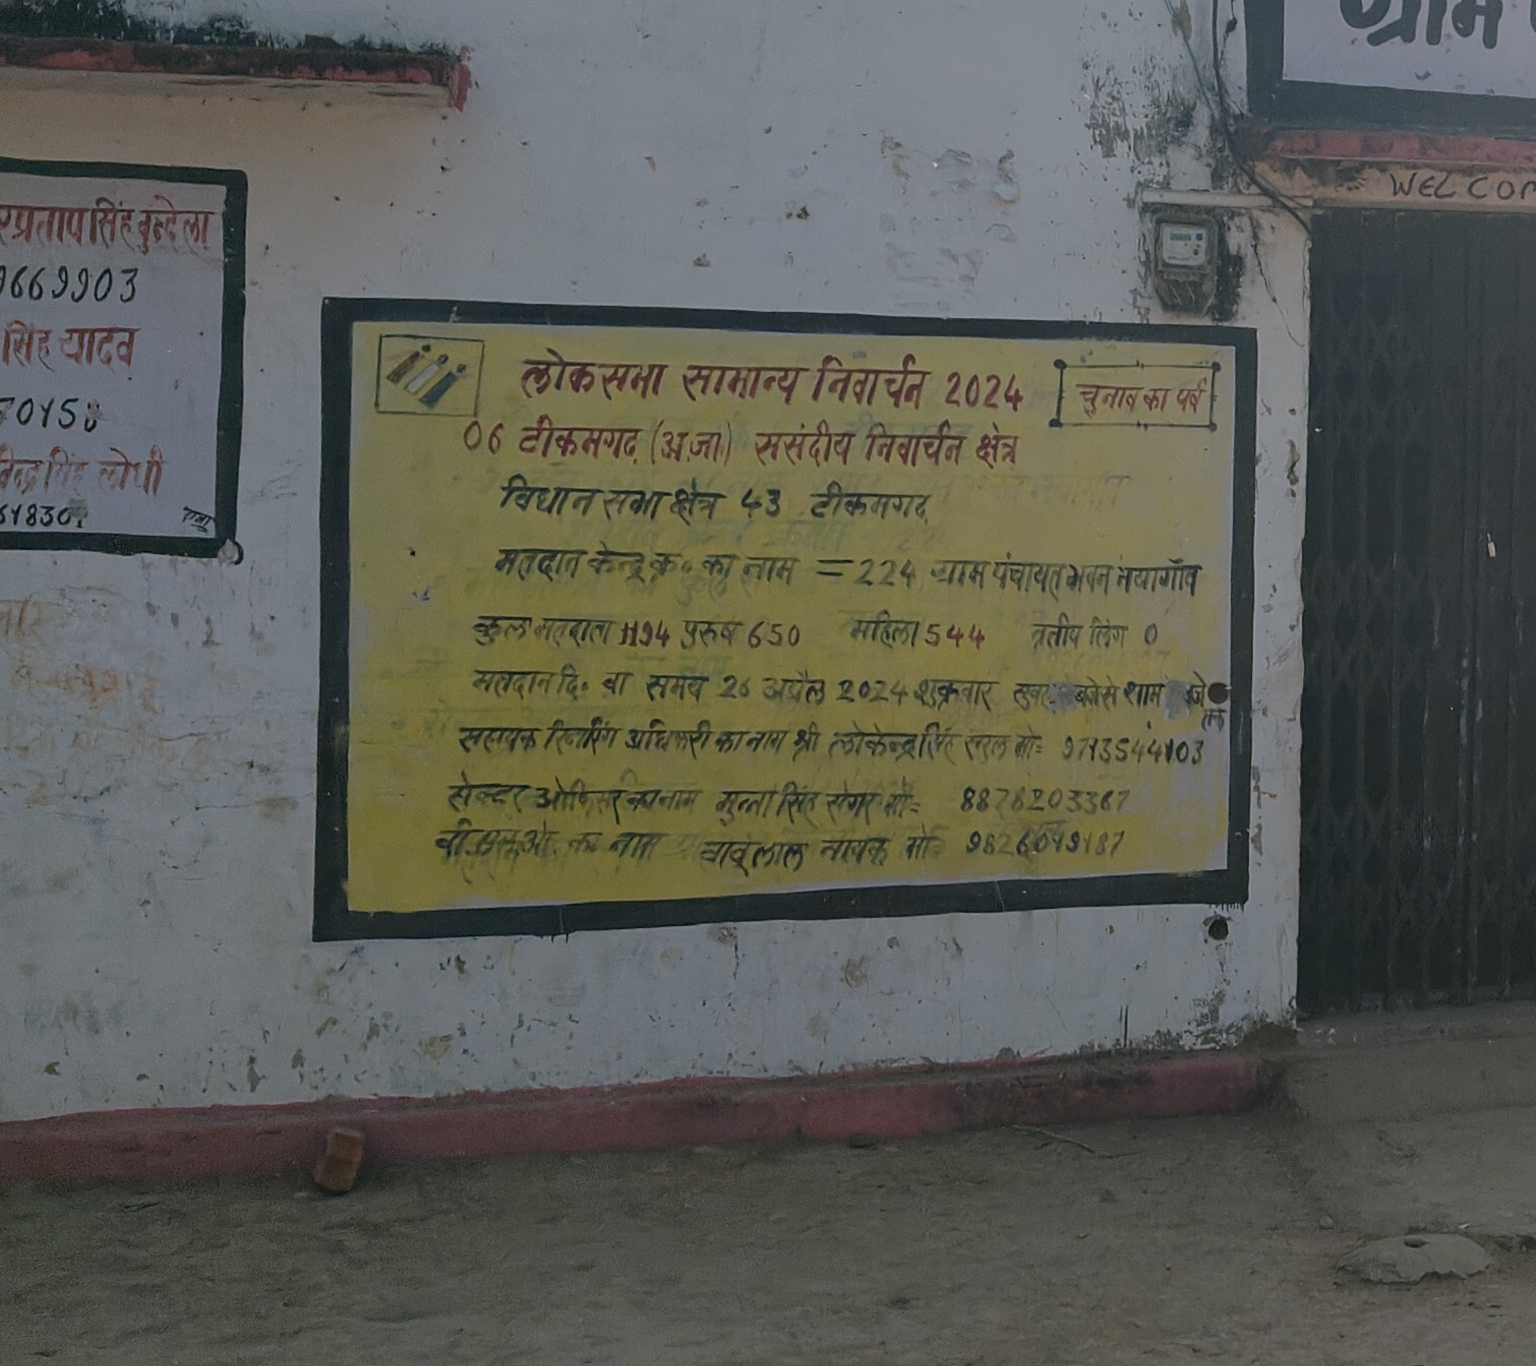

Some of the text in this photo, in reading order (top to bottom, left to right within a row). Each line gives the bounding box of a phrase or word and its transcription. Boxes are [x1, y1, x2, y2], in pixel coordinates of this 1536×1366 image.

[89, 197, 136, 251] सिंह
[60, 327, 141, 370] यादव
[681, 364, 811, 405] सामान्य
[945, 371, 1025, 412] 2024
[463, 420, 504, 455] 06
[518, 413, 645, 465] टीकमगढ़
[975, 423, 1020, 470] क्षेत्र
[740, 488, 782, 519] 43
[702, 553, 741, 580] का
[742, 555, 801, 585] नाम
[472, 615, 533, 647] कुल
[747, 619, 801, 649] 650
[849, 609, 920, 650] महिला
[924, 623, 986, 649] 544
[836, 678, 909, 707] 2024
